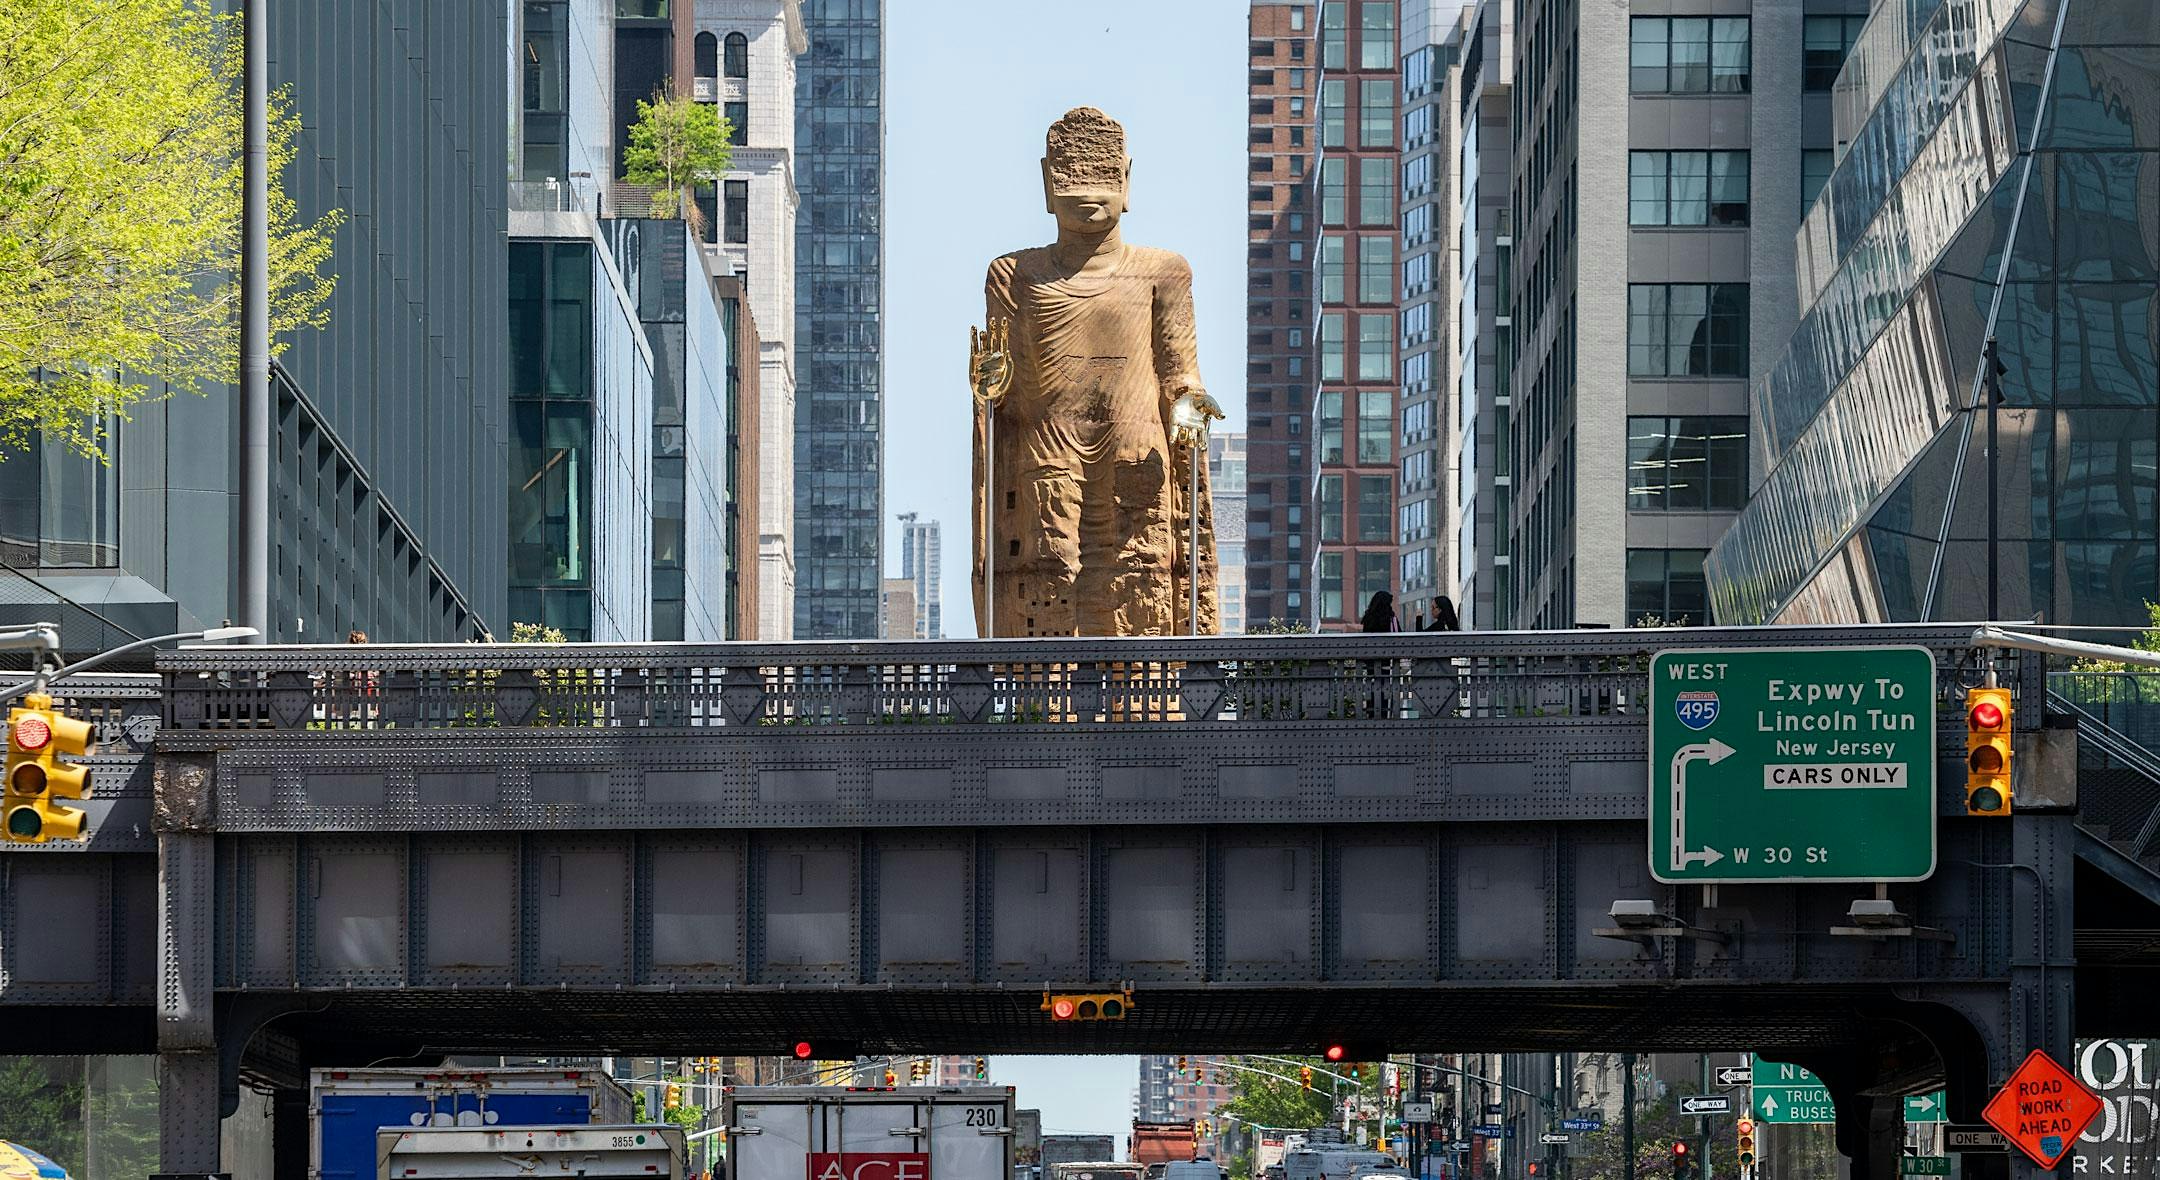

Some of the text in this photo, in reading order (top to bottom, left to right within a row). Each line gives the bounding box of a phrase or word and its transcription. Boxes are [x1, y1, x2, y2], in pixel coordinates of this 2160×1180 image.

[1668, 663, 1728, 680] WEST
[1768, 678, 1905, 706] Expwy To
[1679, 702, 1715, 720] 495
[1758, 709, 1915, 732] Lincoln Tun
[1776, 739, 1896, 759] New Jersey
[1772, 766, 1899, 784] CARS ONLY
[1733, 847, 1828, 864] W 30 St
[1780, 1064, 1818, 1080] Ne
[2075, 1039, 2160, 1090] OL
[1724, 1072, 1740, 1080] ONE
[2019, 1080, 2062, 1096] ROAD
[1785, 1090, 1832, 1103] TRUCK
[1688, 1101, 1701, 1109] ONE
[1790, 1106, 1836, 1119] BUSES
[2020, 1099, 2064, 1115] WORK
[966, 1108, 996, 1127] 230
[1563, 1121, 1579, 1129] West
[2019, 1118, 2072, 1136] AHEAD
[612, 1135, 634, 1148] 3855
[1955, 1133, 2008, 1144] ONE WA
[1906, 1159, 1945, 1173] W 30 St
[2072, 1155, 2160, 1174] RKE
